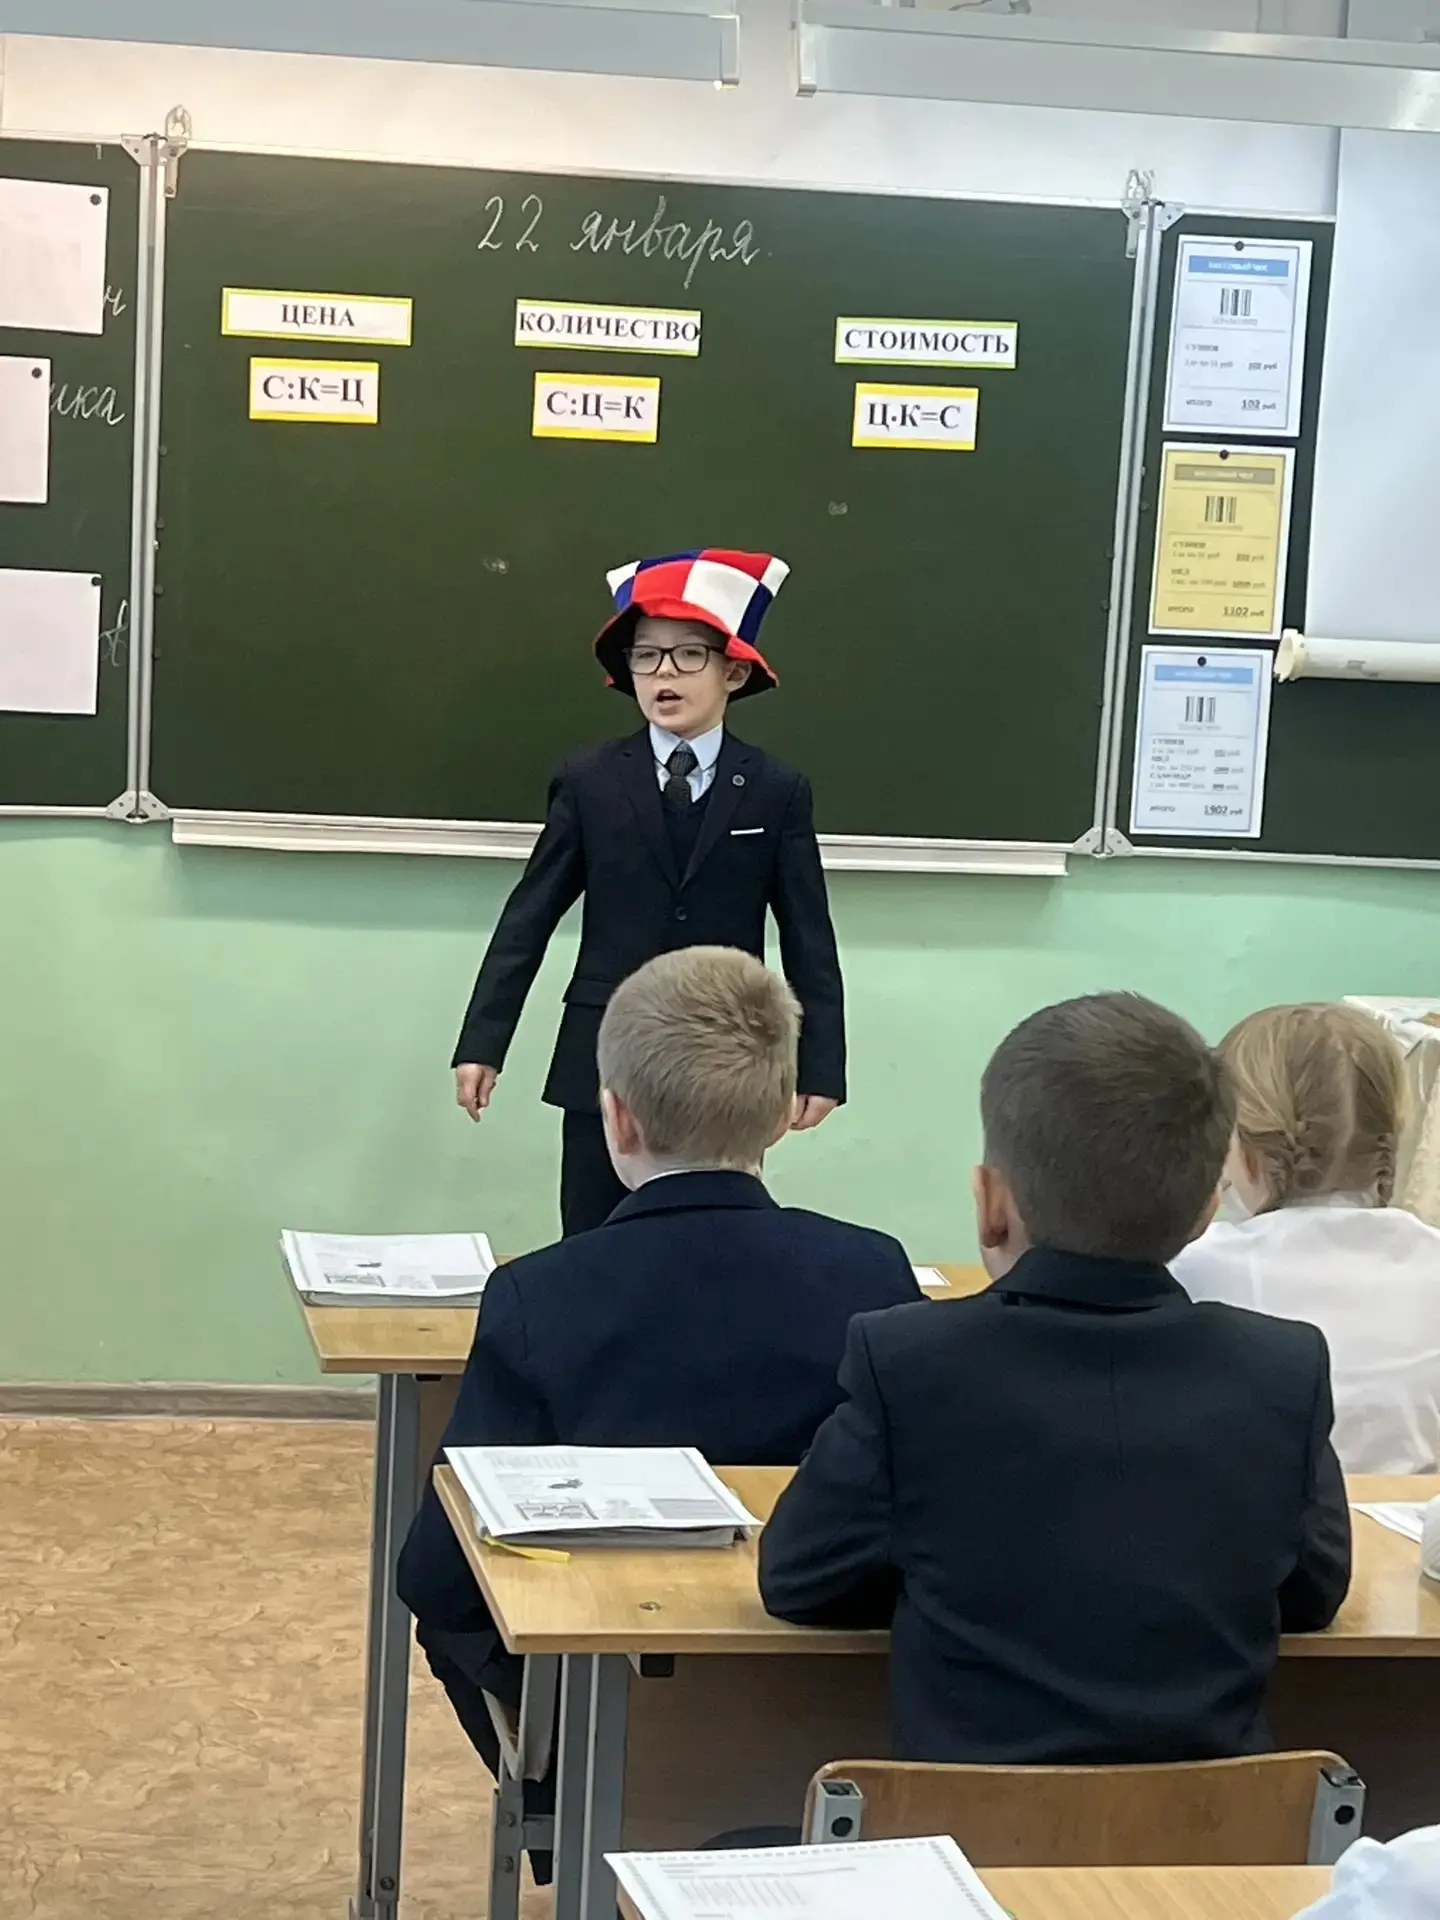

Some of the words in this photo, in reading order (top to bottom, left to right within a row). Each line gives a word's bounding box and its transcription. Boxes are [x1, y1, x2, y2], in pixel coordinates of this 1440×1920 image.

[477, 193, 543, 253] 22
[569, 195, 761, 290] января
[281, 303, 355, 329] ЦЕНА
[518, 311, 702, 342] КОЛИЧЕСТВО
[844, 328, 1010, 355] СТОИМОСТЬ
[262, 374, 365, 408] С:К=Ц
[546, 390, 646, 423] С:Ц=К
